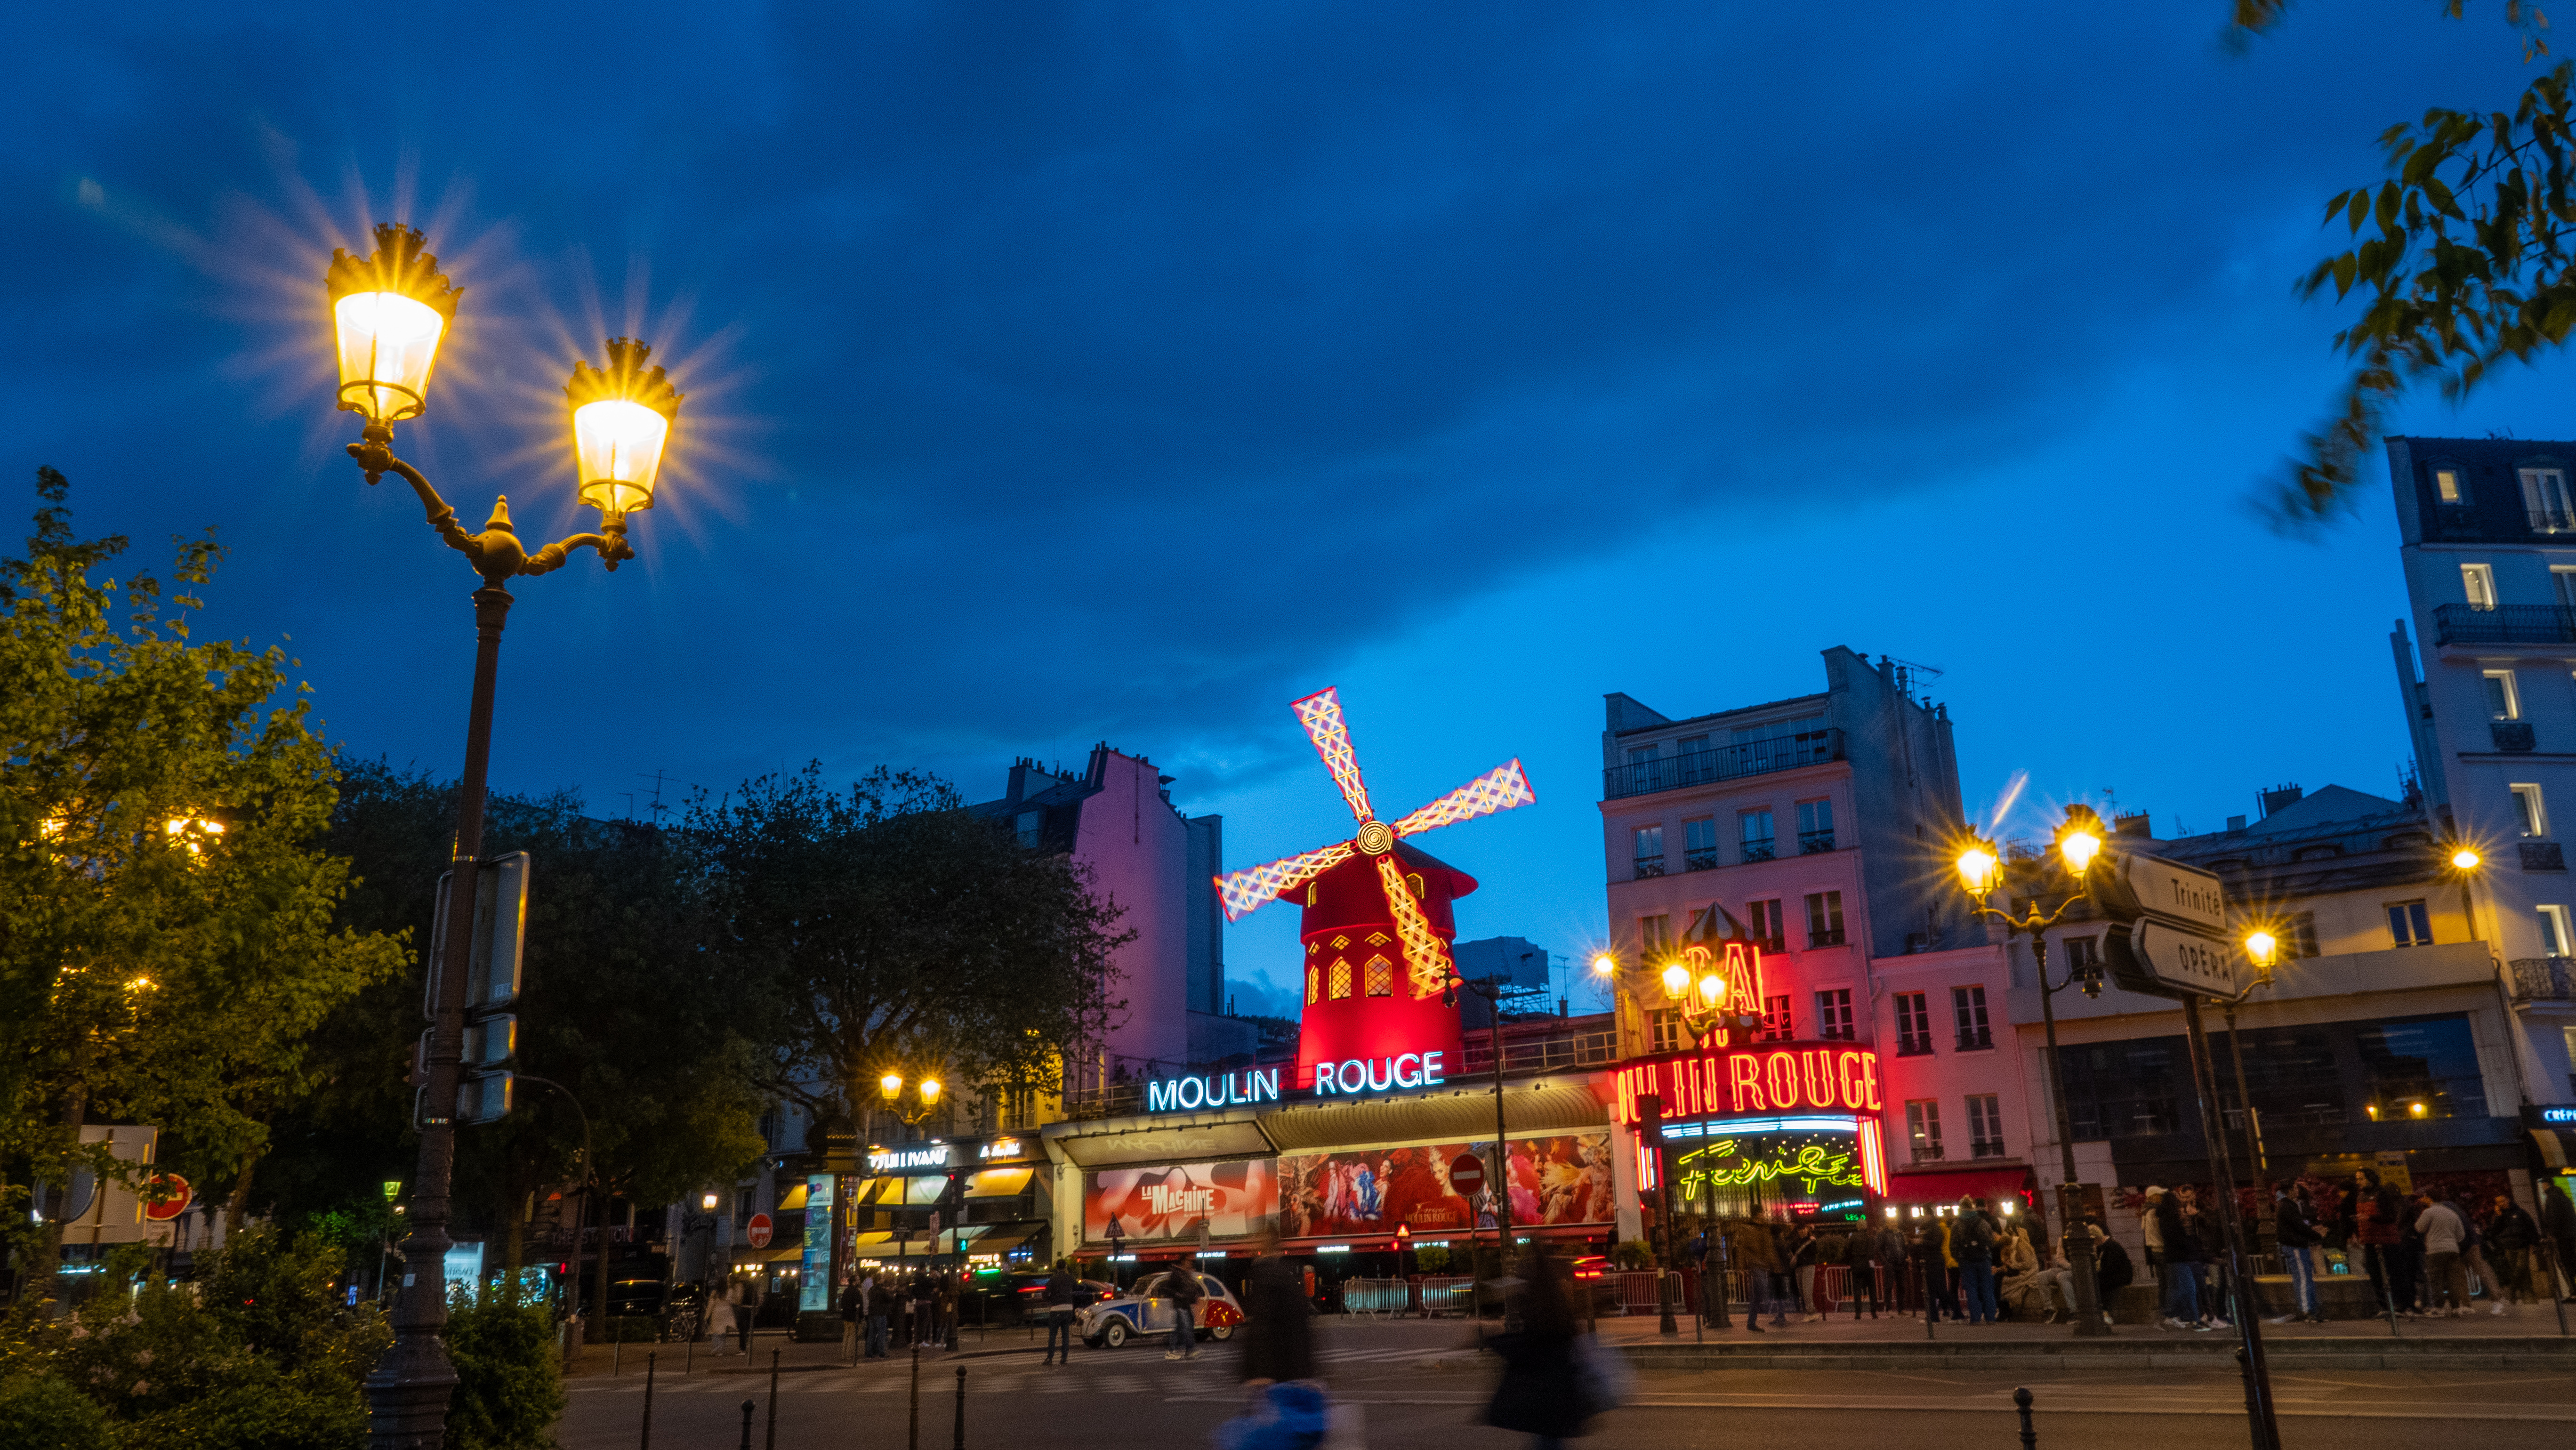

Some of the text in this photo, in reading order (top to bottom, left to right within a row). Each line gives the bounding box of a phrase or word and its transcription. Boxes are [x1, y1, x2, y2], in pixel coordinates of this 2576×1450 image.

[2171, 878, 2222, 917] Trinité
[2179, 943, 2231, 982] OPÉRA
[1149, 1050, 1445, 1112] MOULIN ROUGE
[1731, 1049, 1882, 1112] ROUGE
[1141, 1186, 1152, 1200] LA
